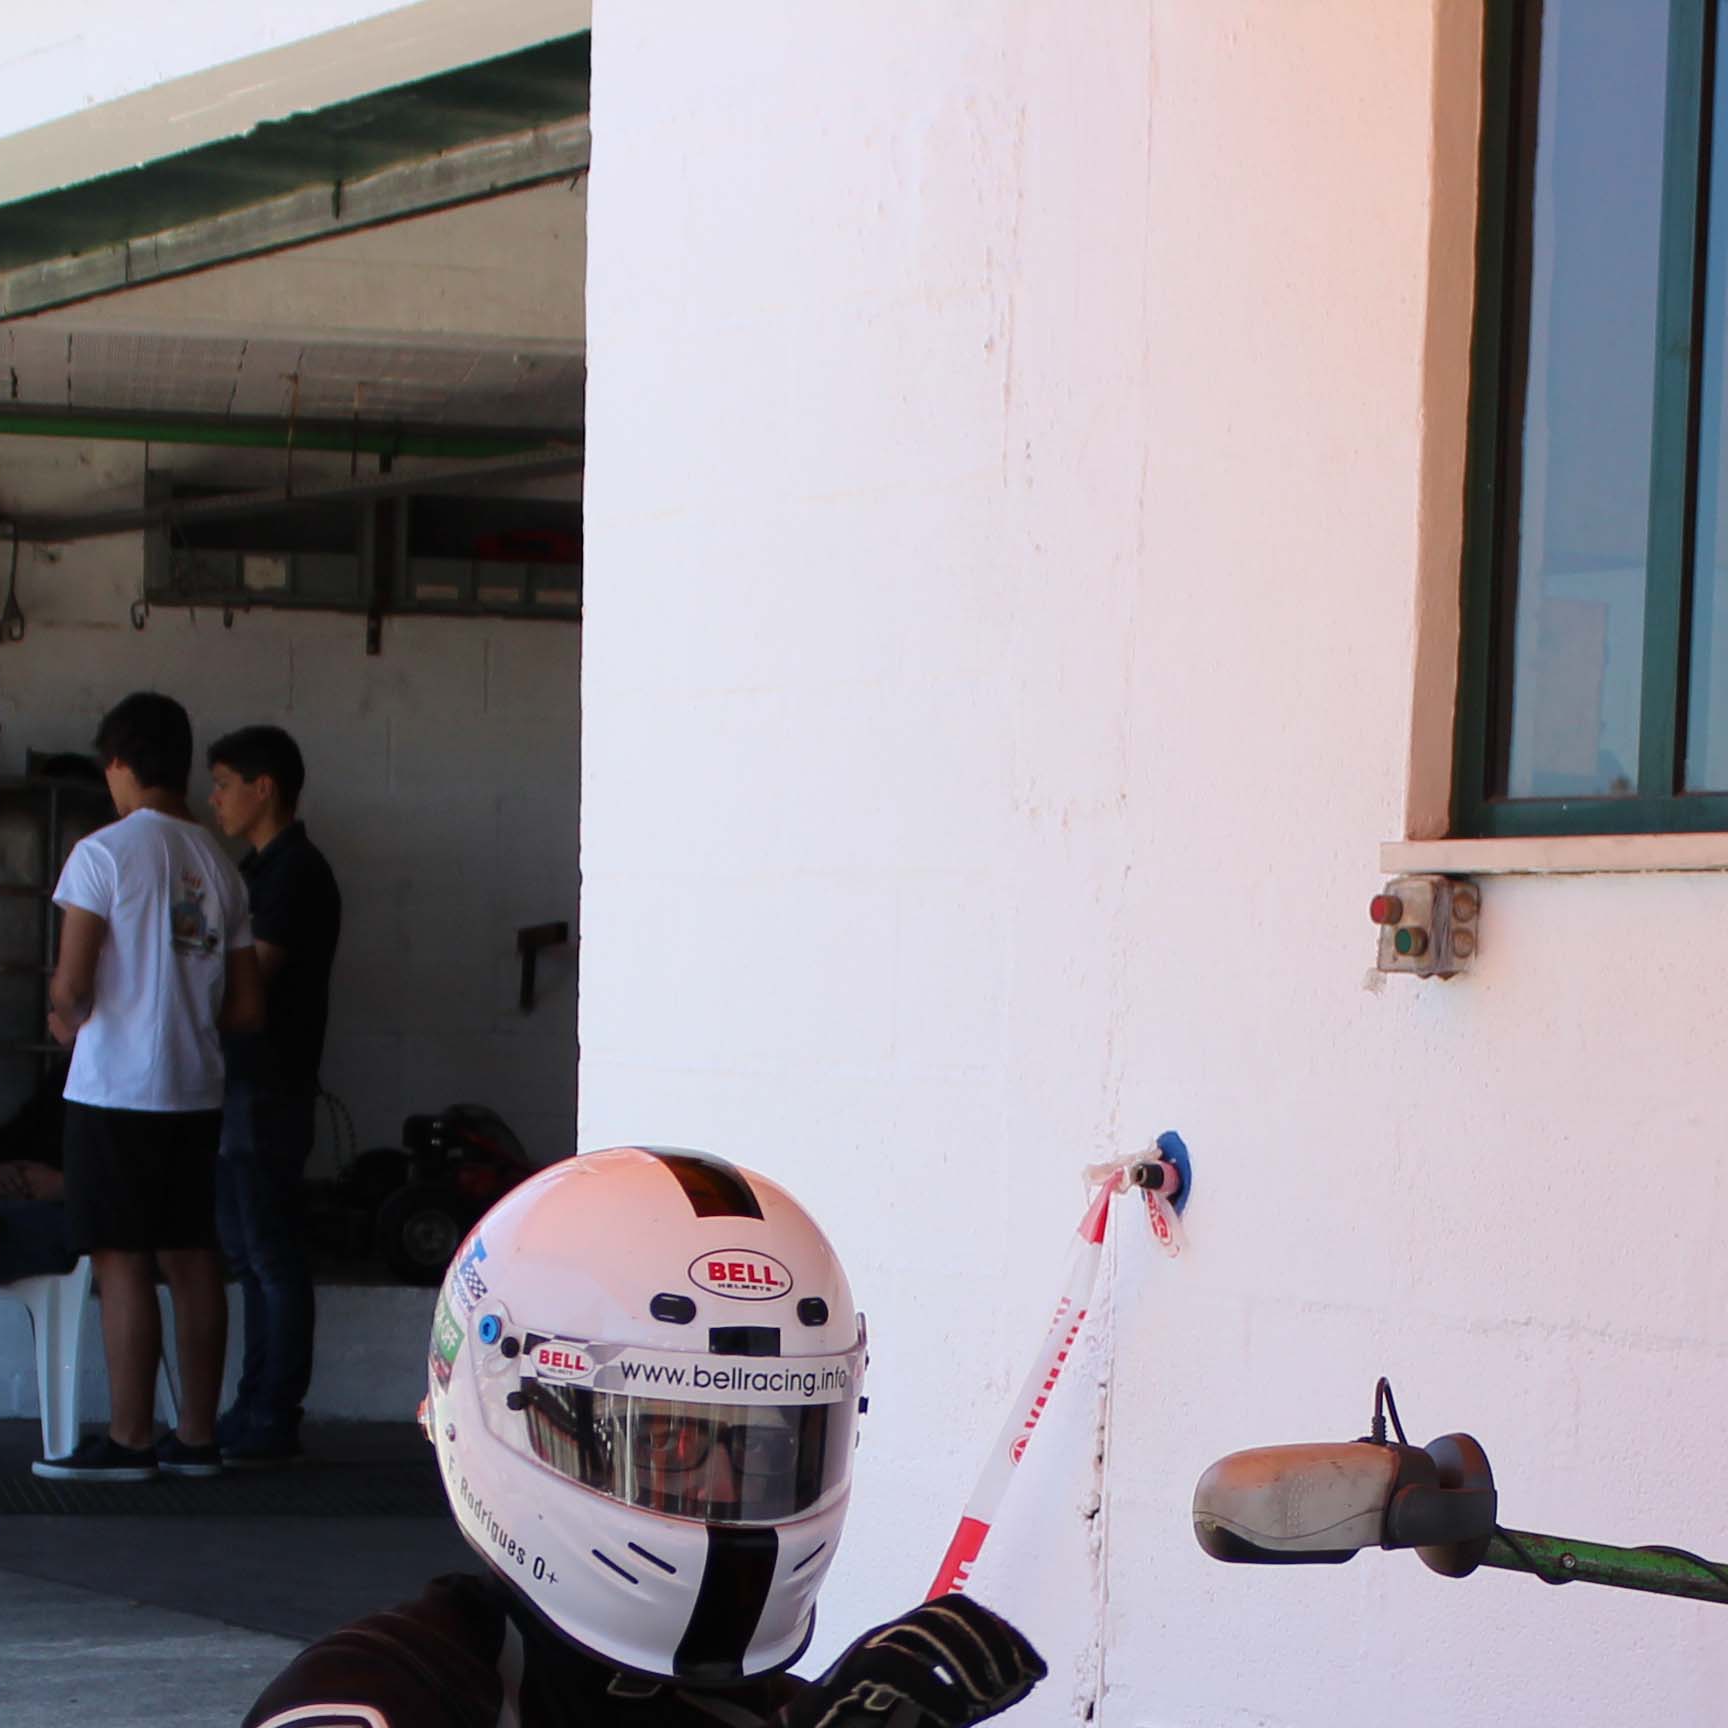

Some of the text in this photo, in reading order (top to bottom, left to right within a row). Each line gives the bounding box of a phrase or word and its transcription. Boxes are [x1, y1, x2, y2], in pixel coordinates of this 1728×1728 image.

[707, 1262, 778, 1286] BELL
[717, 1283, 772, 1292] HELMETS
[538, 1349, 586, 1371] BELL
[620, 1360, 848, 1397] www.bellracing.info
[459, 1475, 527, 1566] Rodrigues
